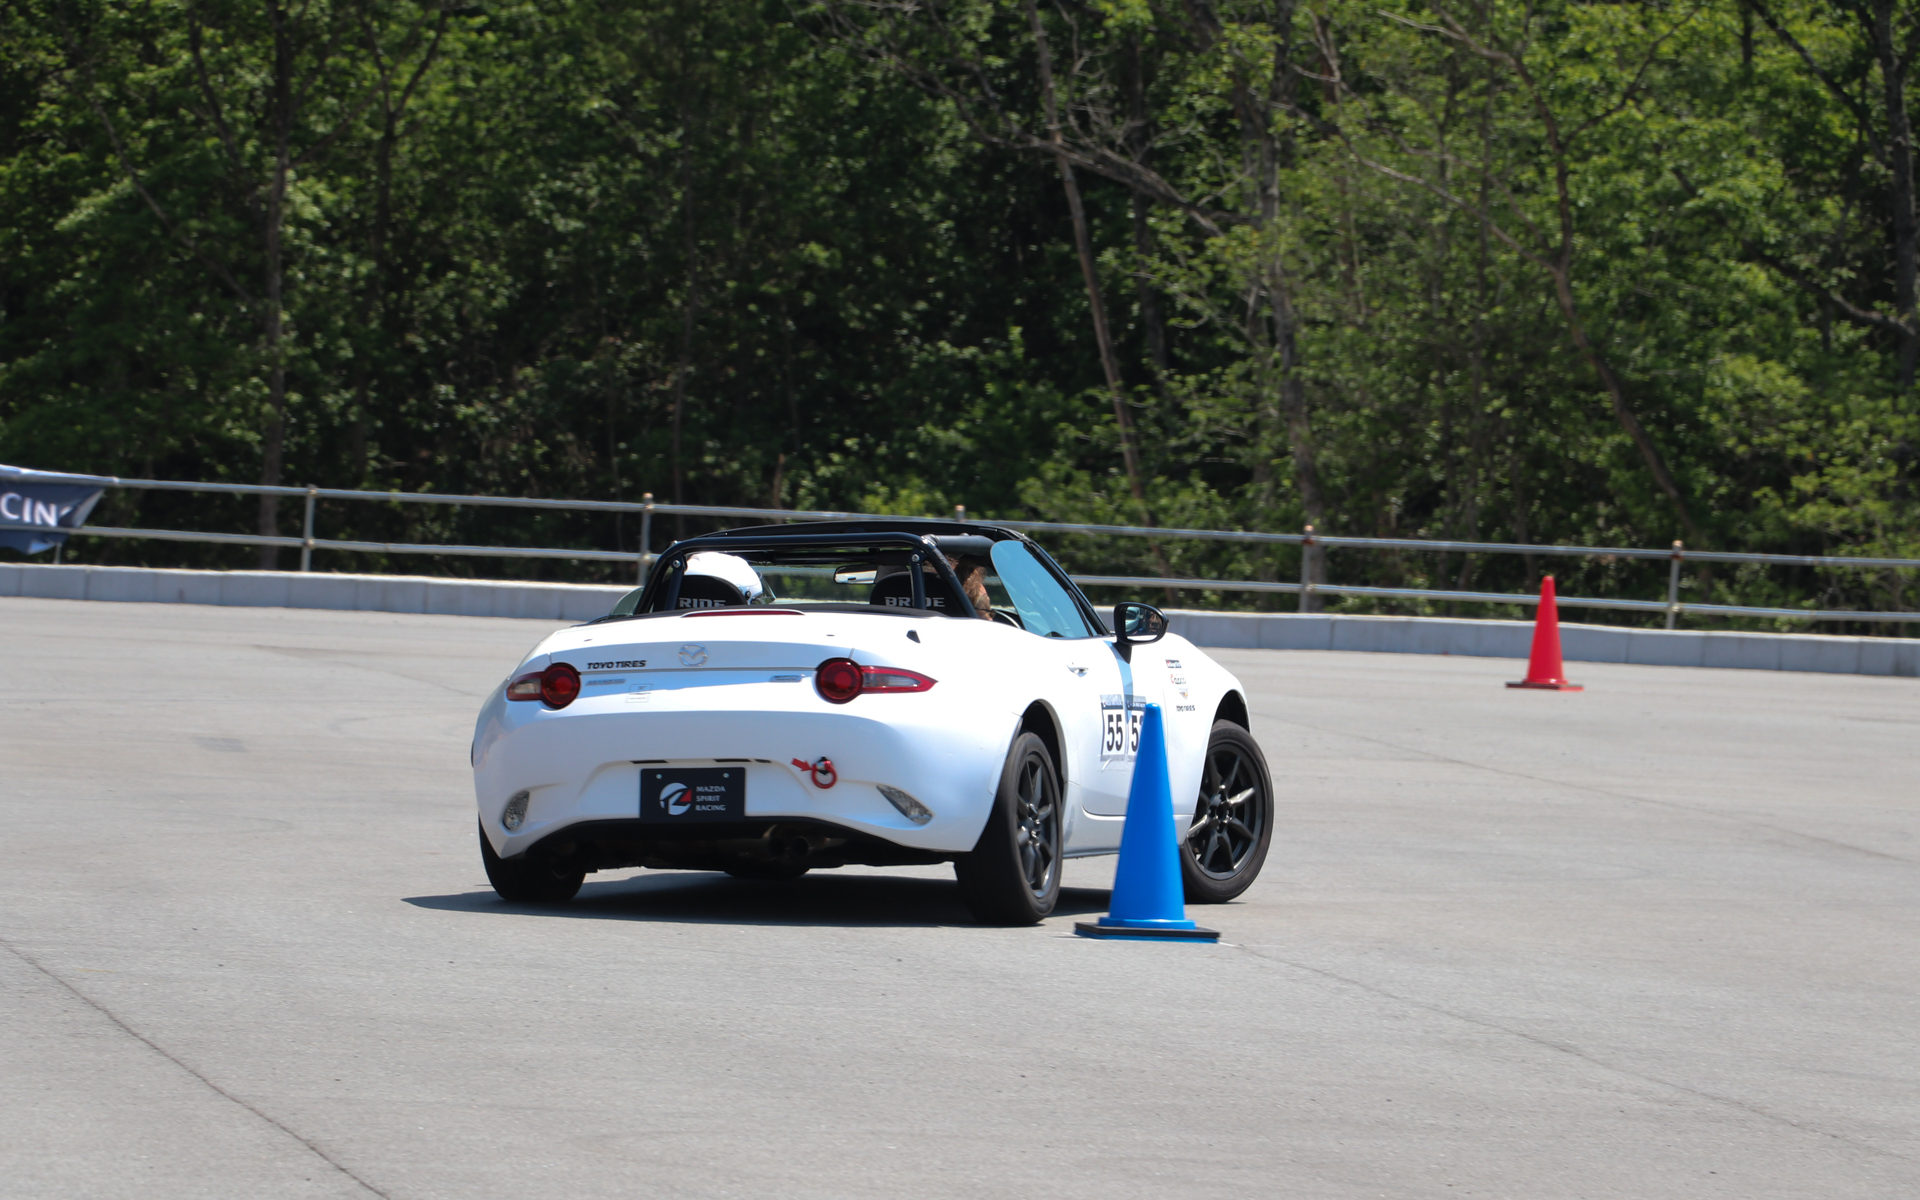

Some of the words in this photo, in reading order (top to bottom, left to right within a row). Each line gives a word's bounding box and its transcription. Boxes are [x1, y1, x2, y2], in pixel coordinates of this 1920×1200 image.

[0, 492, 73, 527] CIN
[679, 597, 726, 608] RIDE
[884, 596, 946, 608] BRDE
[587, 661, 614, 670] TOYO
[615, 659, 647, 669] TIRES
[1106, 713, 1124, 752] 55
[1131, 714, 1144, 753] 5
[695, 785, 726, 793] MAZDA
[695, 804, 726, 812] RACING
